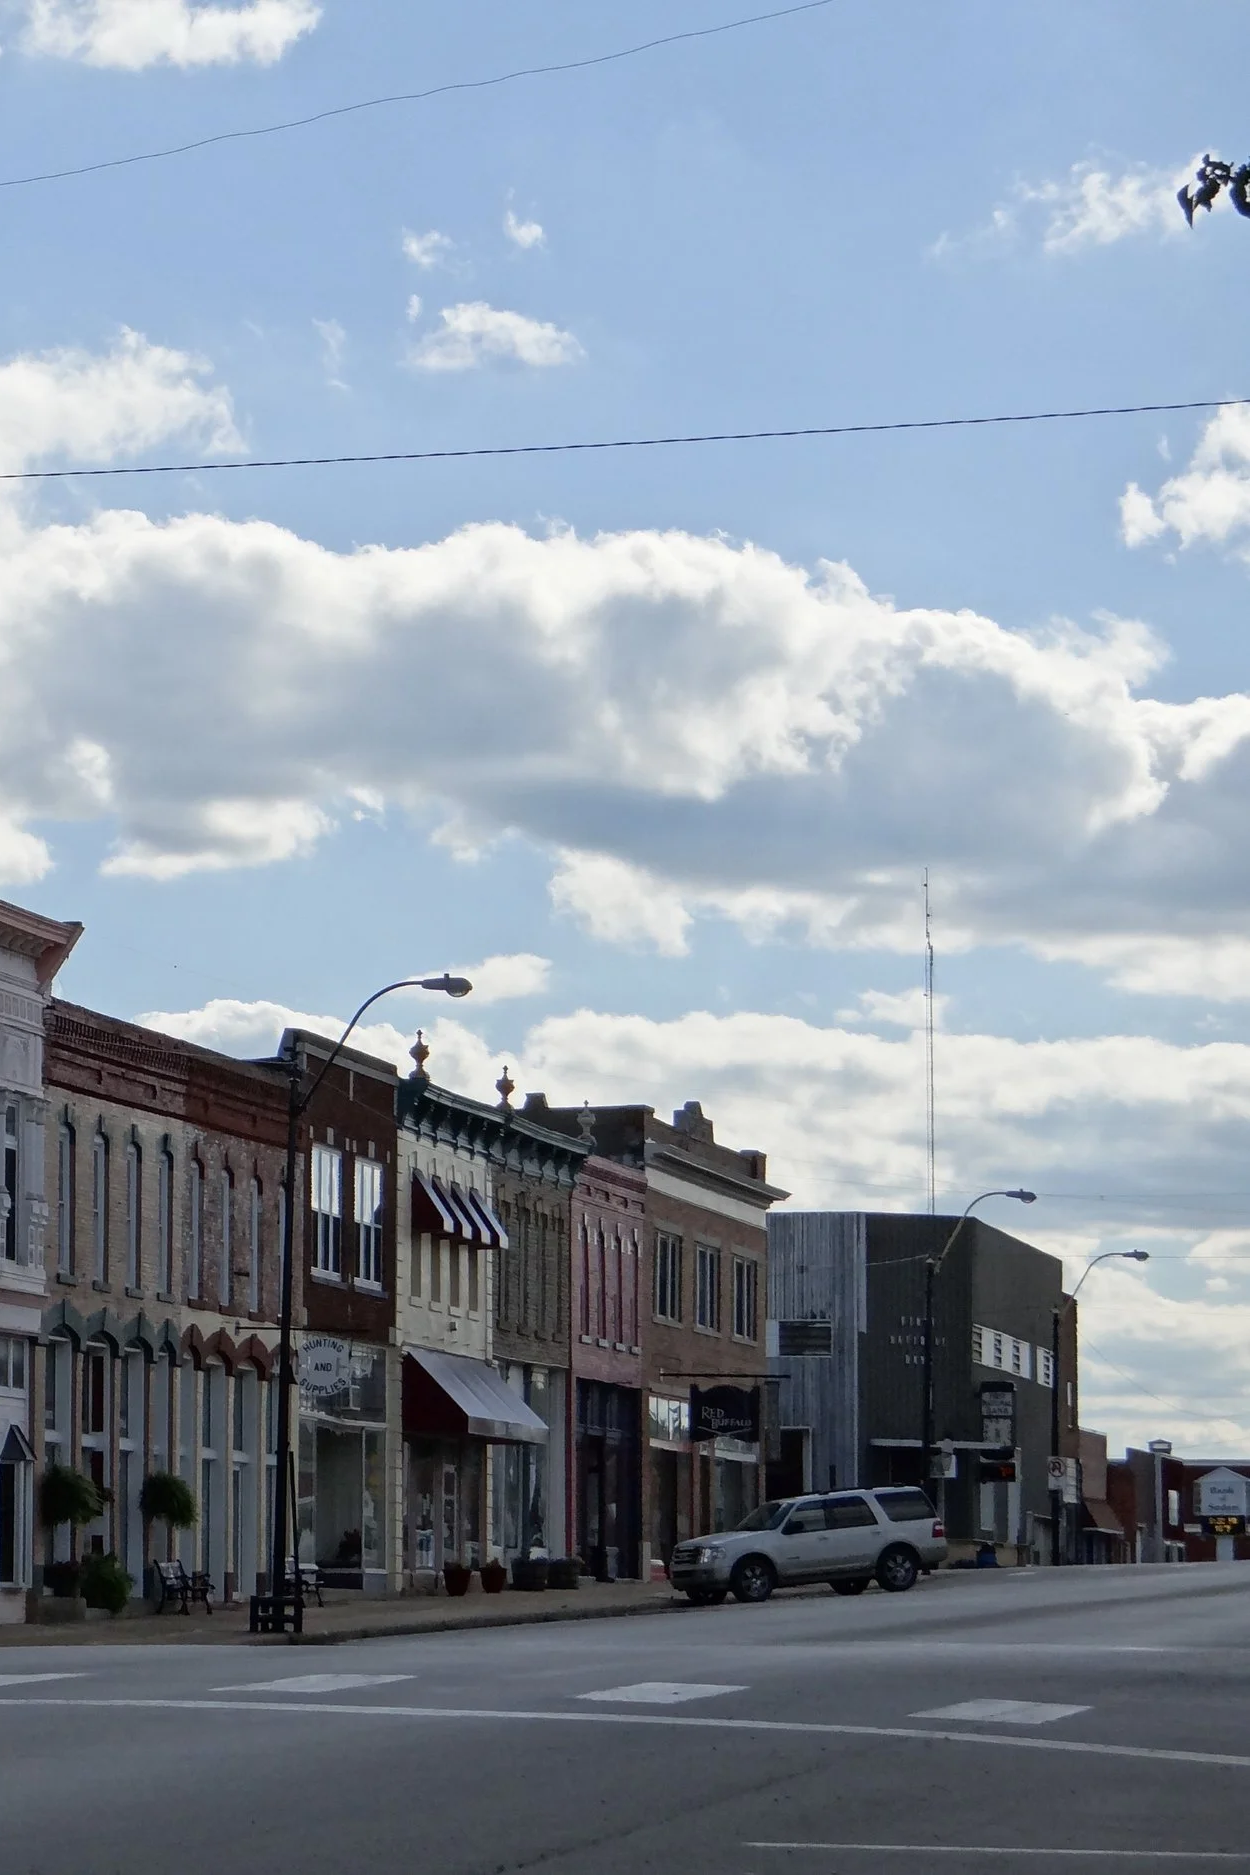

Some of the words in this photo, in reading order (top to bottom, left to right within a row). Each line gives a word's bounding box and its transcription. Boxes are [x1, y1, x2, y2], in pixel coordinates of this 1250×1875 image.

[302, 1338, 344, 1353] HUNTING
[314, 1362, 332, 1372] AND
[299, 1377, 346, 1394] SUPPLIES
[701, 1406, 725, 1419] RED
